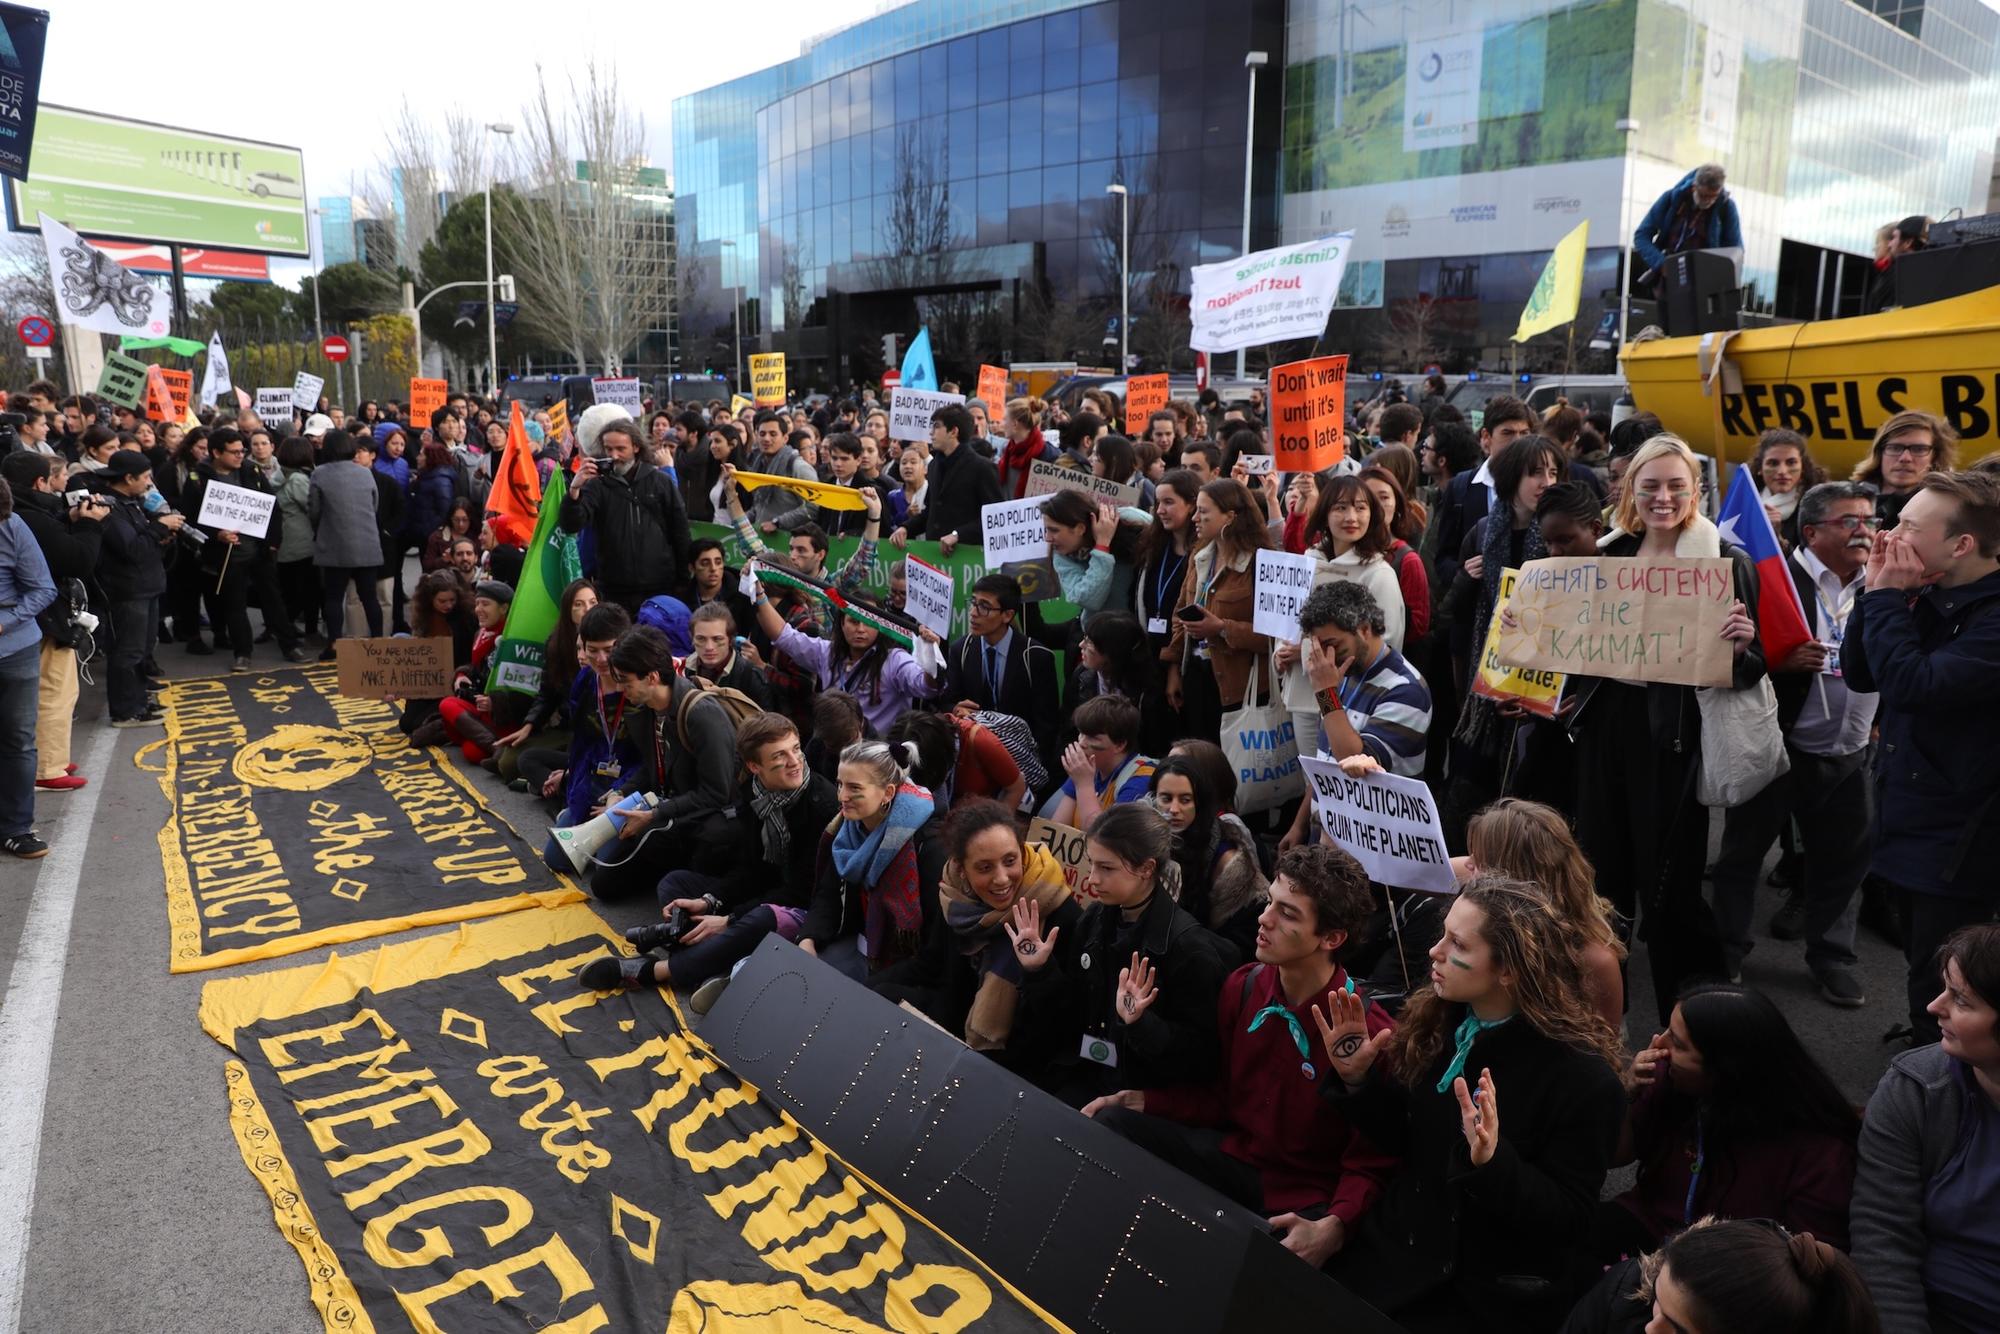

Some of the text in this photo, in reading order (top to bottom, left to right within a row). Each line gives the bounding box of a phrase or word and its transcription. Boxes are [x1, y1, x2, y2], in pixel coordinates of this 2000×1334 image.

[1450, 204, 1497, 215] AMERICAN
[1455, 213, 1496, 223] EXPRESS
[753, 359, 783, 369] CLIMATE
[755, 372, 783, 382] CAN'T
[1129, 379, 1168, 391] Don't wait
[1277, 363, 1345, 393] Don't wait
[413, 383, 430, 392] Don't
[260, 394, 290, 403] CLIMATE
[895, 396, 912, 408] BAD
[1131, 394, 1162, 406] until it's
[1283, 394, 1334, 422] until it's
[1721, 374, 2000, 440] REBELS B
[260, 406, 290, 415] CHANGE
[1128, 410, 1144, 422] too
[895, 414, 912, 426] RUIN
[914, 415, 928, 428] THE
[1280, 427, 1341, 451] too late.
[1094, 479, 1119, 497] PERO
[209, 488, 272, 512] BAD POLITICIANS
[205, 503, 269, 526] RUIN THE PLANET!
[986, 505, 1043, 530] BAD POLITIC
[989, 530, 1009, 551] RUIN
[1011, 531, 1025, 547] THE
[907, 564, 920, 583] BAD
[1260, 563, 1275, 583] BAD
[1259, 592, 1275, 612] RUIN
[1277, 594, 1287, 615] THE
[385, 647, 401, 657] ARE
[404, 645, 433, 656] NEVER
[515, 644, 543, 661] Wir
[376, 657, 438, 666] TOO SMALL TO
[361, 670, 387, 687] MAKE
[390, 667, 398, 687] A
[504, 668, 525, 683] bis
[1239, 721, 1295, 751] WIND
[181, 758, 228, 783] IN
[1314, 773, 1431, 825] BAD POLITICIANS
[308, 811, 394, 876] the
[1327, 810, 1444, 865] RUIN THE PLANET!
[180, 783, 301, 938] EMERGENCY
[433, 845, 527, 885] UP
[257, 1008, 610, 1334] EMERGE
